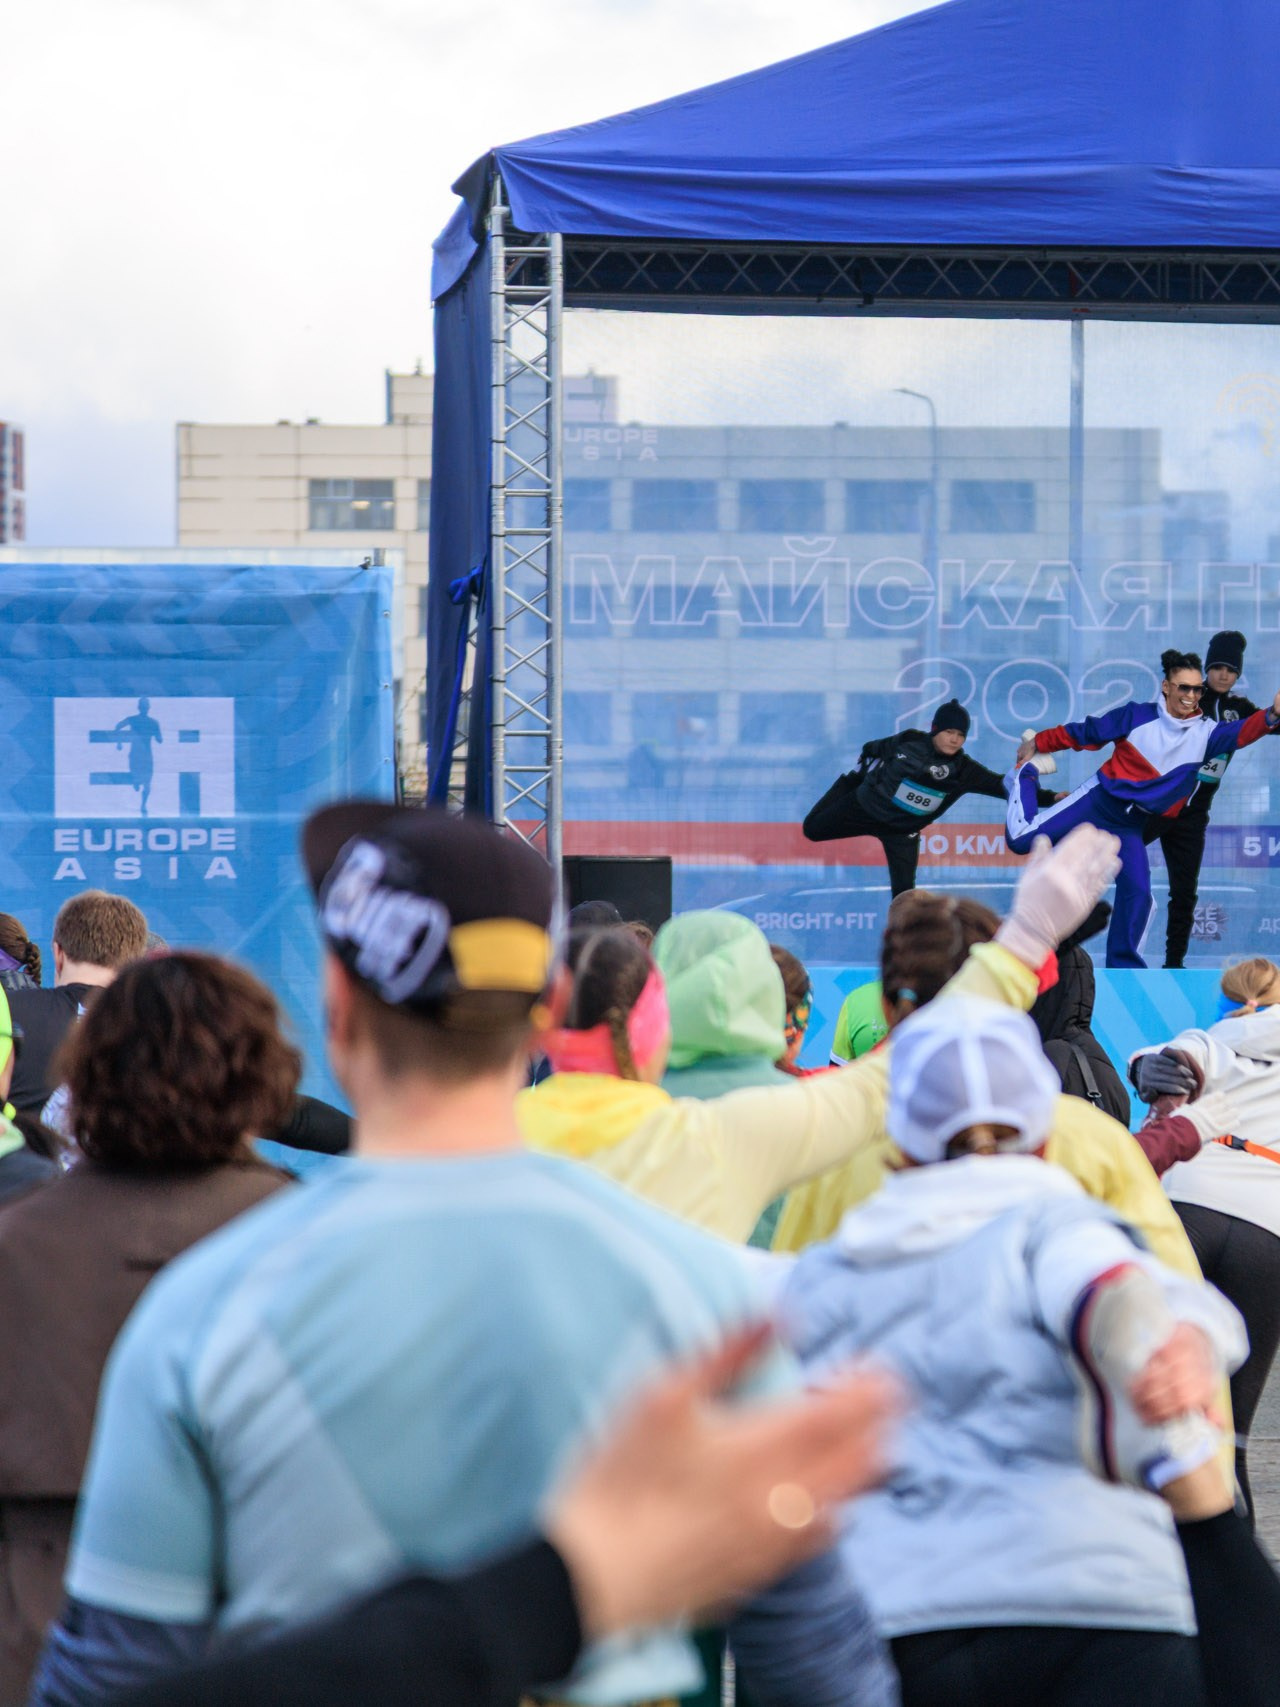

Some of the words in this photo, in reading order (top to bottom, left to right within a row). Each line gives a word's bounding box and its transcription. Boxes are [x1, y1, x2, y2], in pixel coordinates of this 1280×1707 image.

[564, 427, 658, 444] UROPE
[569, 536, 1172, 632] МАЙСКАЯ
[906, 791, 932, 807] 898
[54, 828, 236, 852] EUROPE
[955, 834, 1005, 855] KM
[1243, 836, 1262, 856] 5
[53, 857, 237, 881] ASIA
